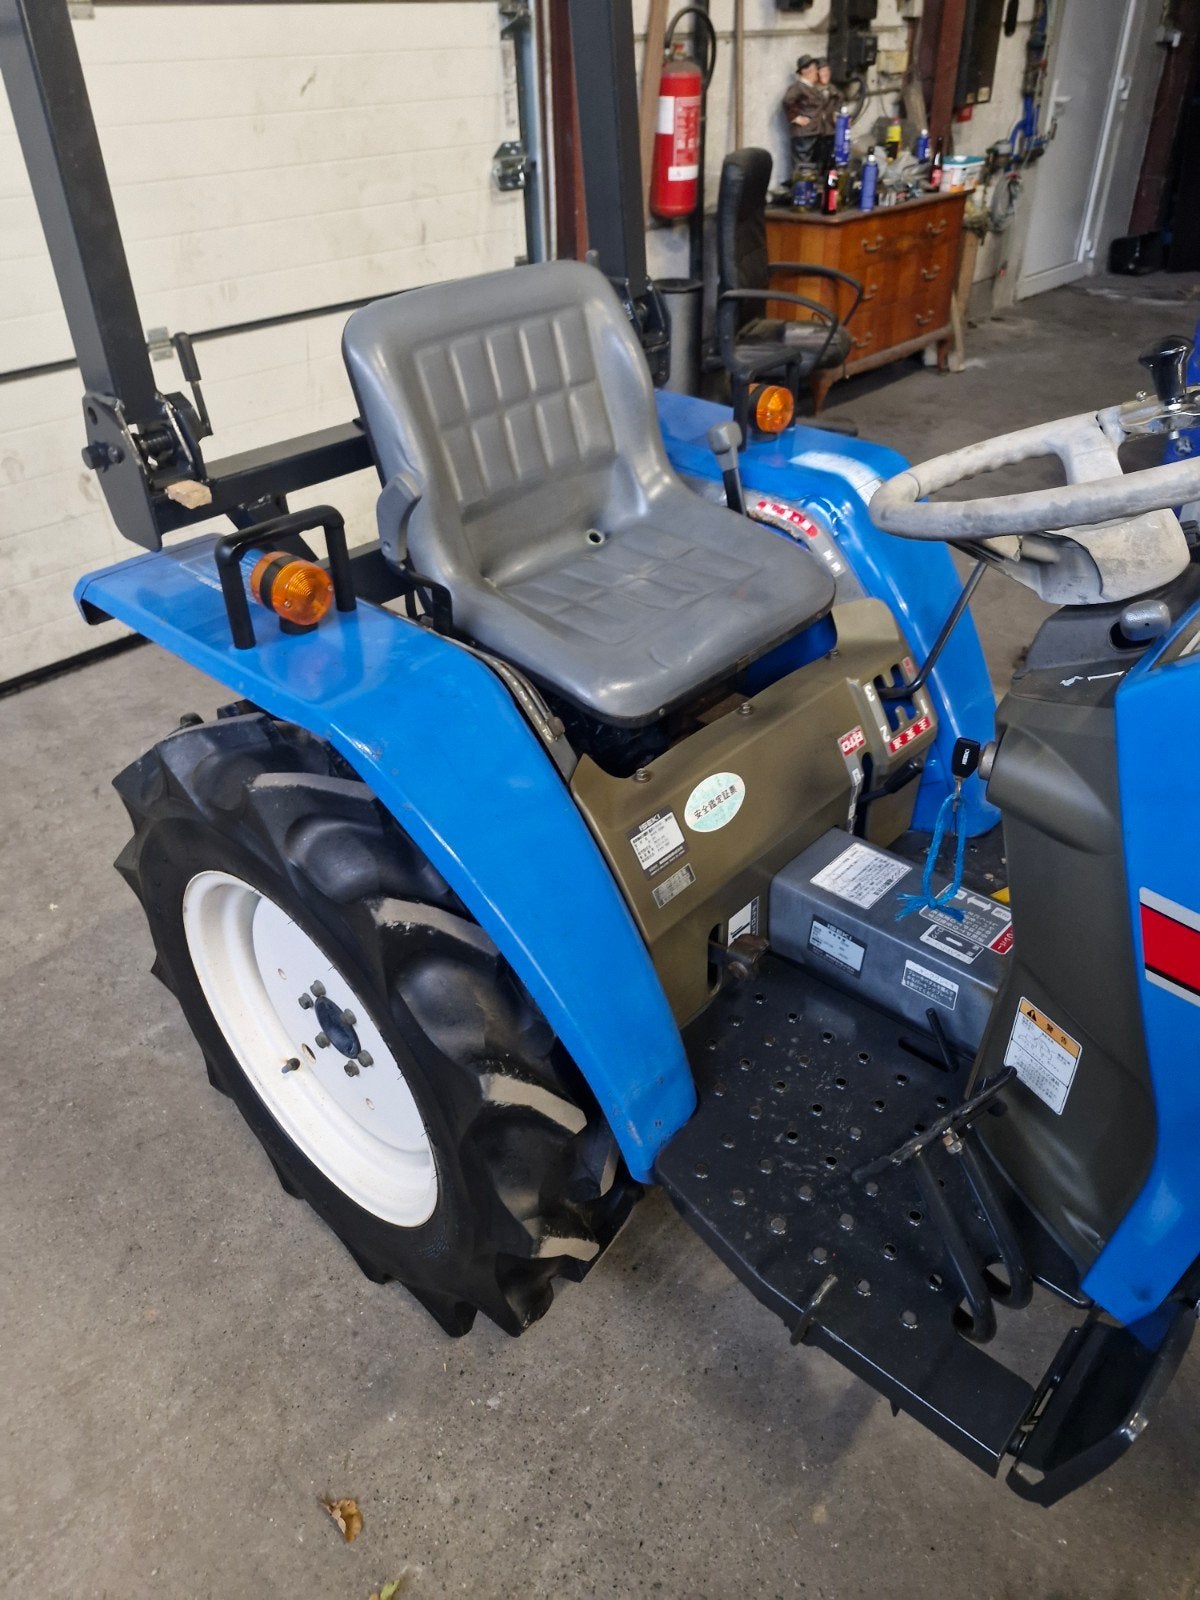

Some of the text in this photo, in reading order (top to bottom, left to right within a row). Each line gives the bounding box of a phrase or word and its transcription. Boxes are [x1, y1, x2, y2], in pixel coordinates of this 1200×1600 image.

[863, 684, 876, 702] 3
[879, 725, 891, 742] 2
[827, 923, 852, 941] ISEKI
